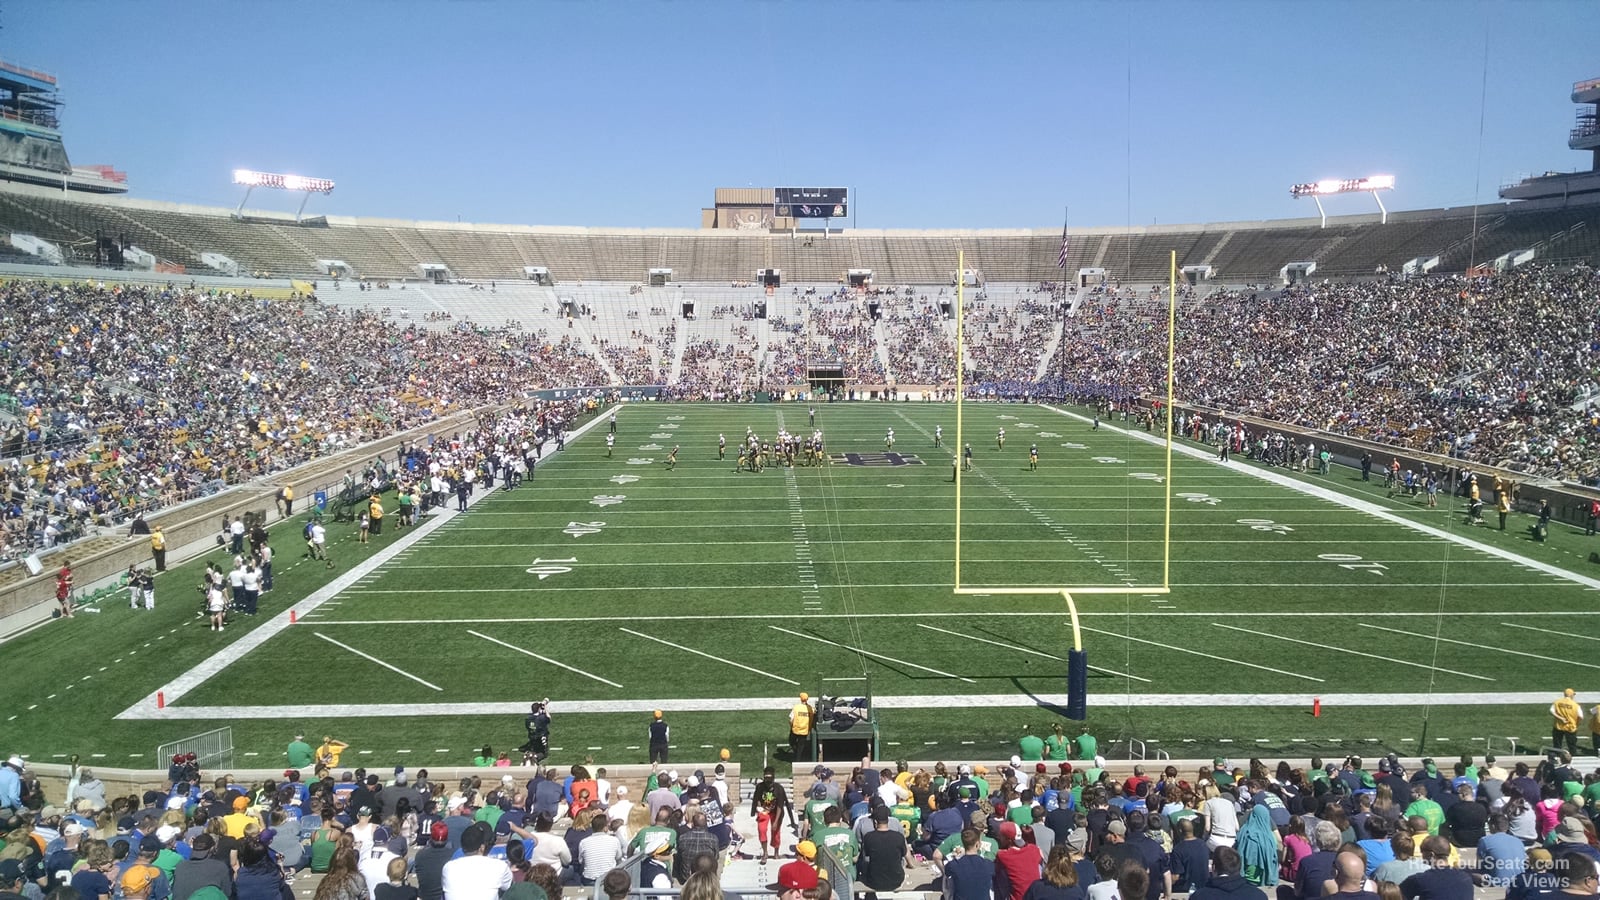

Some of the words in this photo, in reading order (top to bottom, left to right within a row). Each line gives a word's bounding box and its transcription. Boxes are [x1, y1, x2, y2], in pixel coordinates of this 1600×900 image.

[562, 521, 607, 534] 20
[1236, 518, 1295, 531] 20
[526, 557, 578, 574] 10
[1317, 553, 1390, 570] 10
[422, 819, 433, 835] 11
